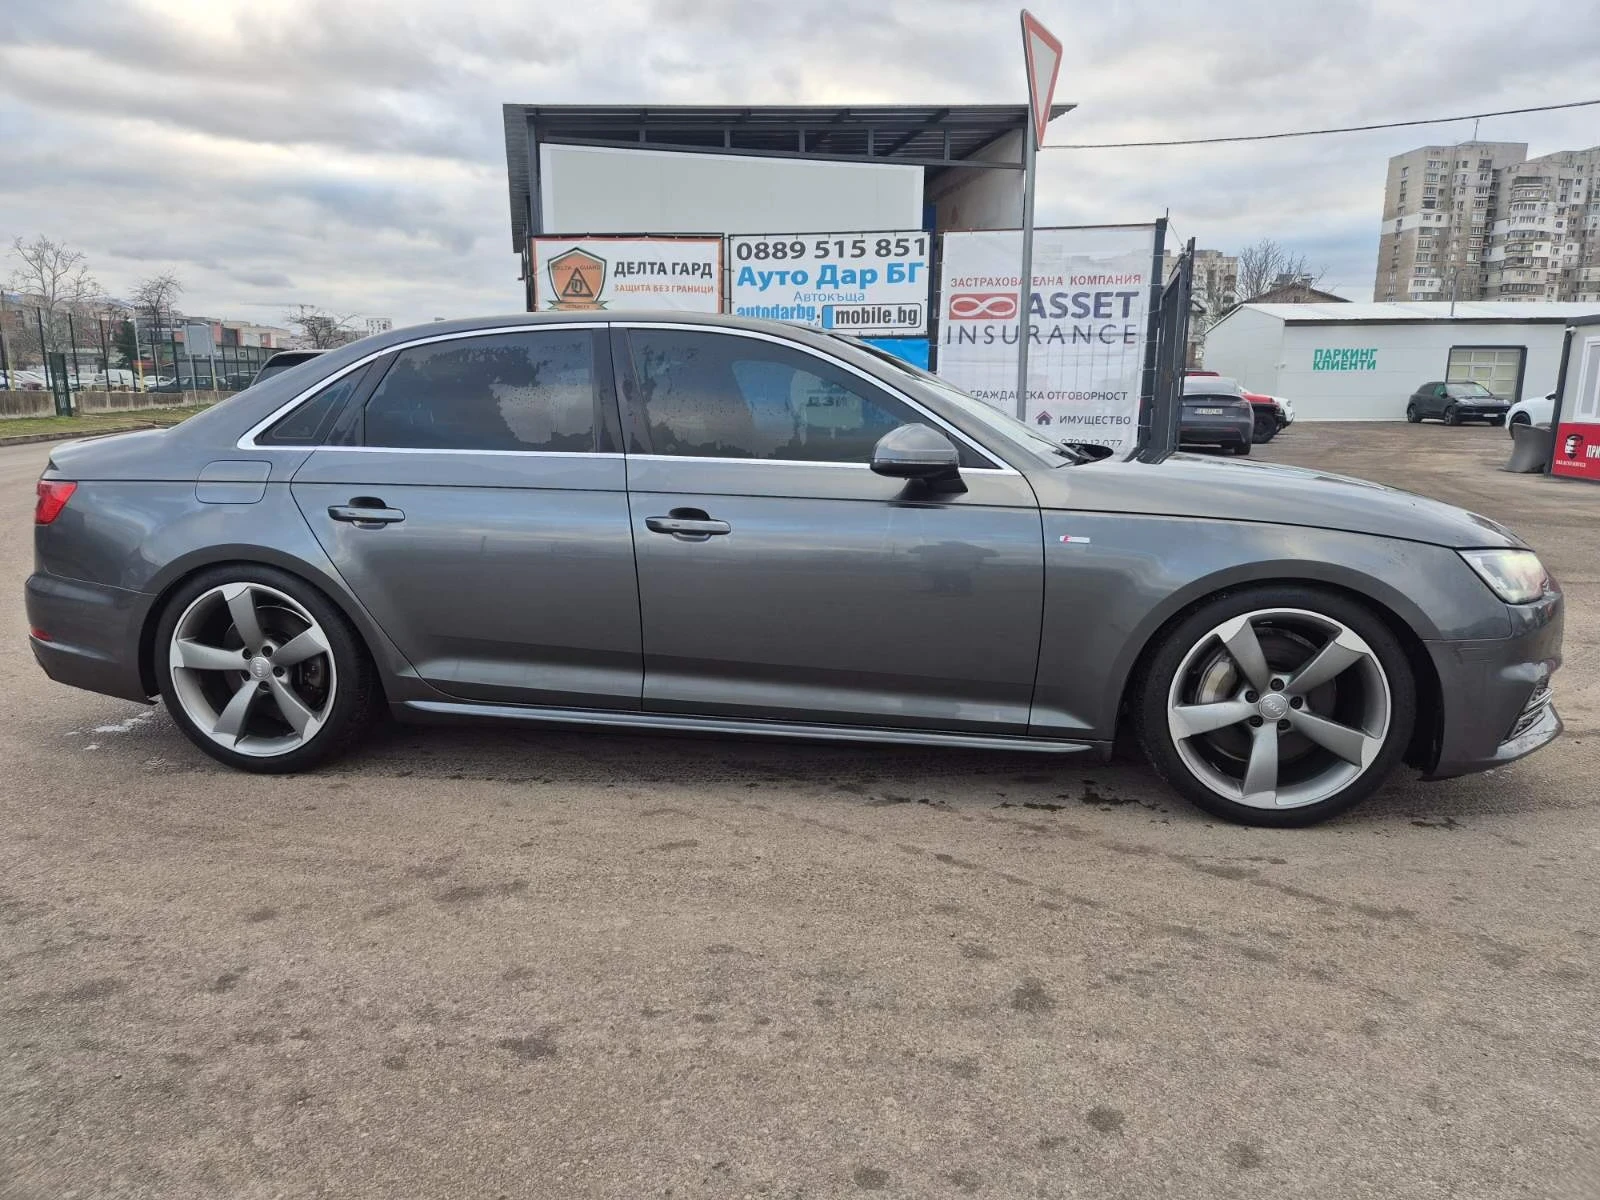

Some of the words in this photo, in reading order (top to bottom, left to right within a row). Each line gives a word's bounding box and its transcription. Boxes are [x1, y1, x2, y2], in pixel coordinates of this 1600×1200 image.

[736, 241, 806, 260] 0889
[814, 239, 866, 259] 515
[875, 238, 925, 257] 851
[614, 261, 667, 278] ДЕЛТА
[671, 262, 713, 279] ГАРД
[737, 266, 809, 292] Ауто
[816, 264, 878, 290] Дар
[886, 262, 924, 284] БГ
[950, 275, 1063, 288] ЗАСТРАХОВАЕЛНА
[1070, 274, 1142, 287] КОМПАНИЯ
[614, 283, 651, 293] ЗАЩИТА
[653, 284, 670, 293] БЕЗ
[671, 284, 714, 294] ГРАНИЦИ
[793, 291, 865, 303] Автокъща
[1028, 291, 1139, 319] ASSET
[835, 307, 918, 326] mobile.bg
[946, 323, 1138, 345] INSURANCE
[1314, 348, 1378, 360] ПАРКИНГ
[1313, 359, 1377, 370] КЛИЕНТИ
[1047, 391, 1129, 401] ОТГОВОРНОСТ
[1059, 415, 1131, 426] ИМУЩЕСТВО
